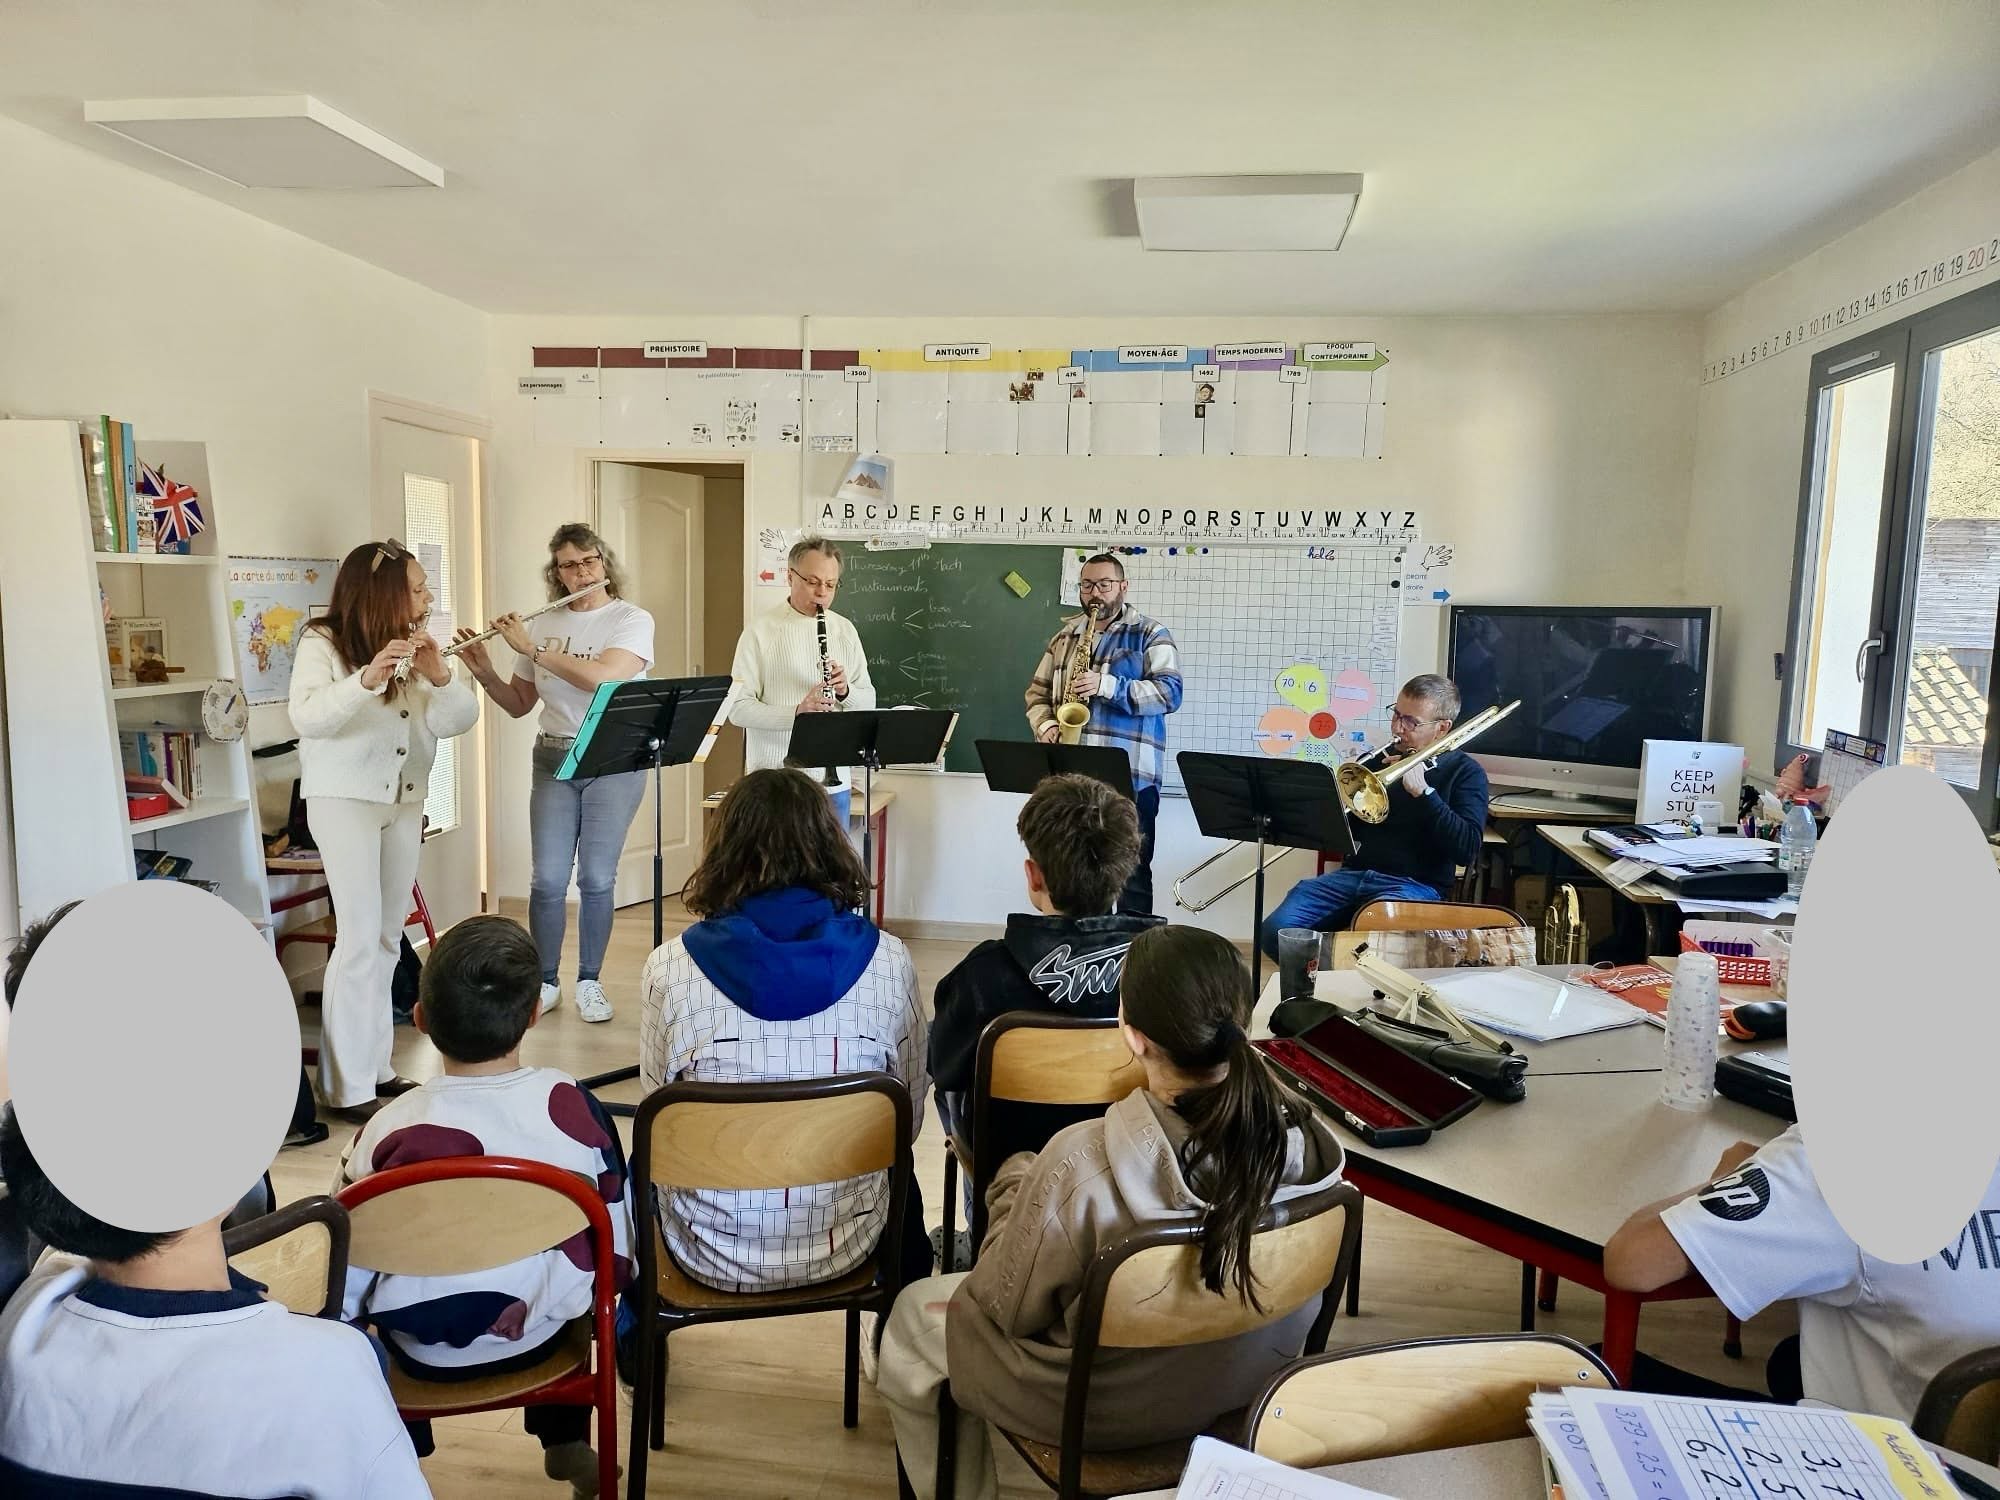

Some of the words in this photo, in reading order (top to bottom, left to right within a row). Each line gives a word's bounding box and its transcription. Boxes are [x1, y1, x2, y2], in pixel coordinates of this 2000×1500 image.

[1809, 318, 1820, 336] 10
[1822, 313, 1831, 331] 11
[1836, 306, 1846, 325] 12
[1849, 300, 1860, 319] 13
[1864, 292, 1876, 312] 14
[1881, 285, 1892, 305] 15
[1896, 278, 1909, 298] 16
[1914, 269, 1928, 292] 17
[1933, 262, 1945, 283] 18
[1950, 255, 1963, 277] 19
[1967, 247, 1985, 271] 20
[1990, 239, 2000, 261] 2
[649, 344, 701, 353] PREHISTOIRE
[935, 348, 980, 357] ANTIQUITE
[1127, 348, 1178, 357] MOYEN-ÂGE
[1242, 347, 1283, 355] MODERNES
[822, 503, 833, 519] A
[844, 503, 855, 519] B
[866, 504, 877, 520] C
[887, 504, 898, 519] D
[910, 505, 920, 521] E
[932, 505, 942, 521] F
[953, 505, 965, 522] G
[975, 505, 986, 522] H
[1000, 507, 1004, 523] I
[1019, 506, 1028, 523] J
[1041, 506, 1052, 523] K
[1064, 507, 1073, 523] L
[1088, 508, 1102, 524] M
[1116, 508, 1127, 525] N
[1137, 508, 1150, 525] O
[1161, 509, 1173, 525] P
[1183, 509, 1196, 527] Q
[1206, 510, 1219, 527] R
[1230, 510, 1241, 527] S
[1254, 511, 1266, 528] T
[1277, 511, 1289, 528] U
[1301, 510, 1313, 527] V
[1325, 511, 1342, 528] W
[1355, 511, 1367, 528] X
[1380, 511, 1392, 527] Y
[1403, 511, 1415, 528] Z
[1307, 546, 1335, 560] hello
[228, 569, 239, 581] La
[242, 571, 263, 582] carte
[1281, 678, 1295, 688] 70
[1308, 681, 1317, 693] 6
[1674, 769, 1714, 782] KEEP
[1670, 781, 1715, 795] CALM
[1666, 800, 1695, 812] STU
[1615, 1407, 1648, 1438] 3,79
[1636, 1450, 1668, 1477] 2,5
[1881, 1431, 1923, 1478] Addition
